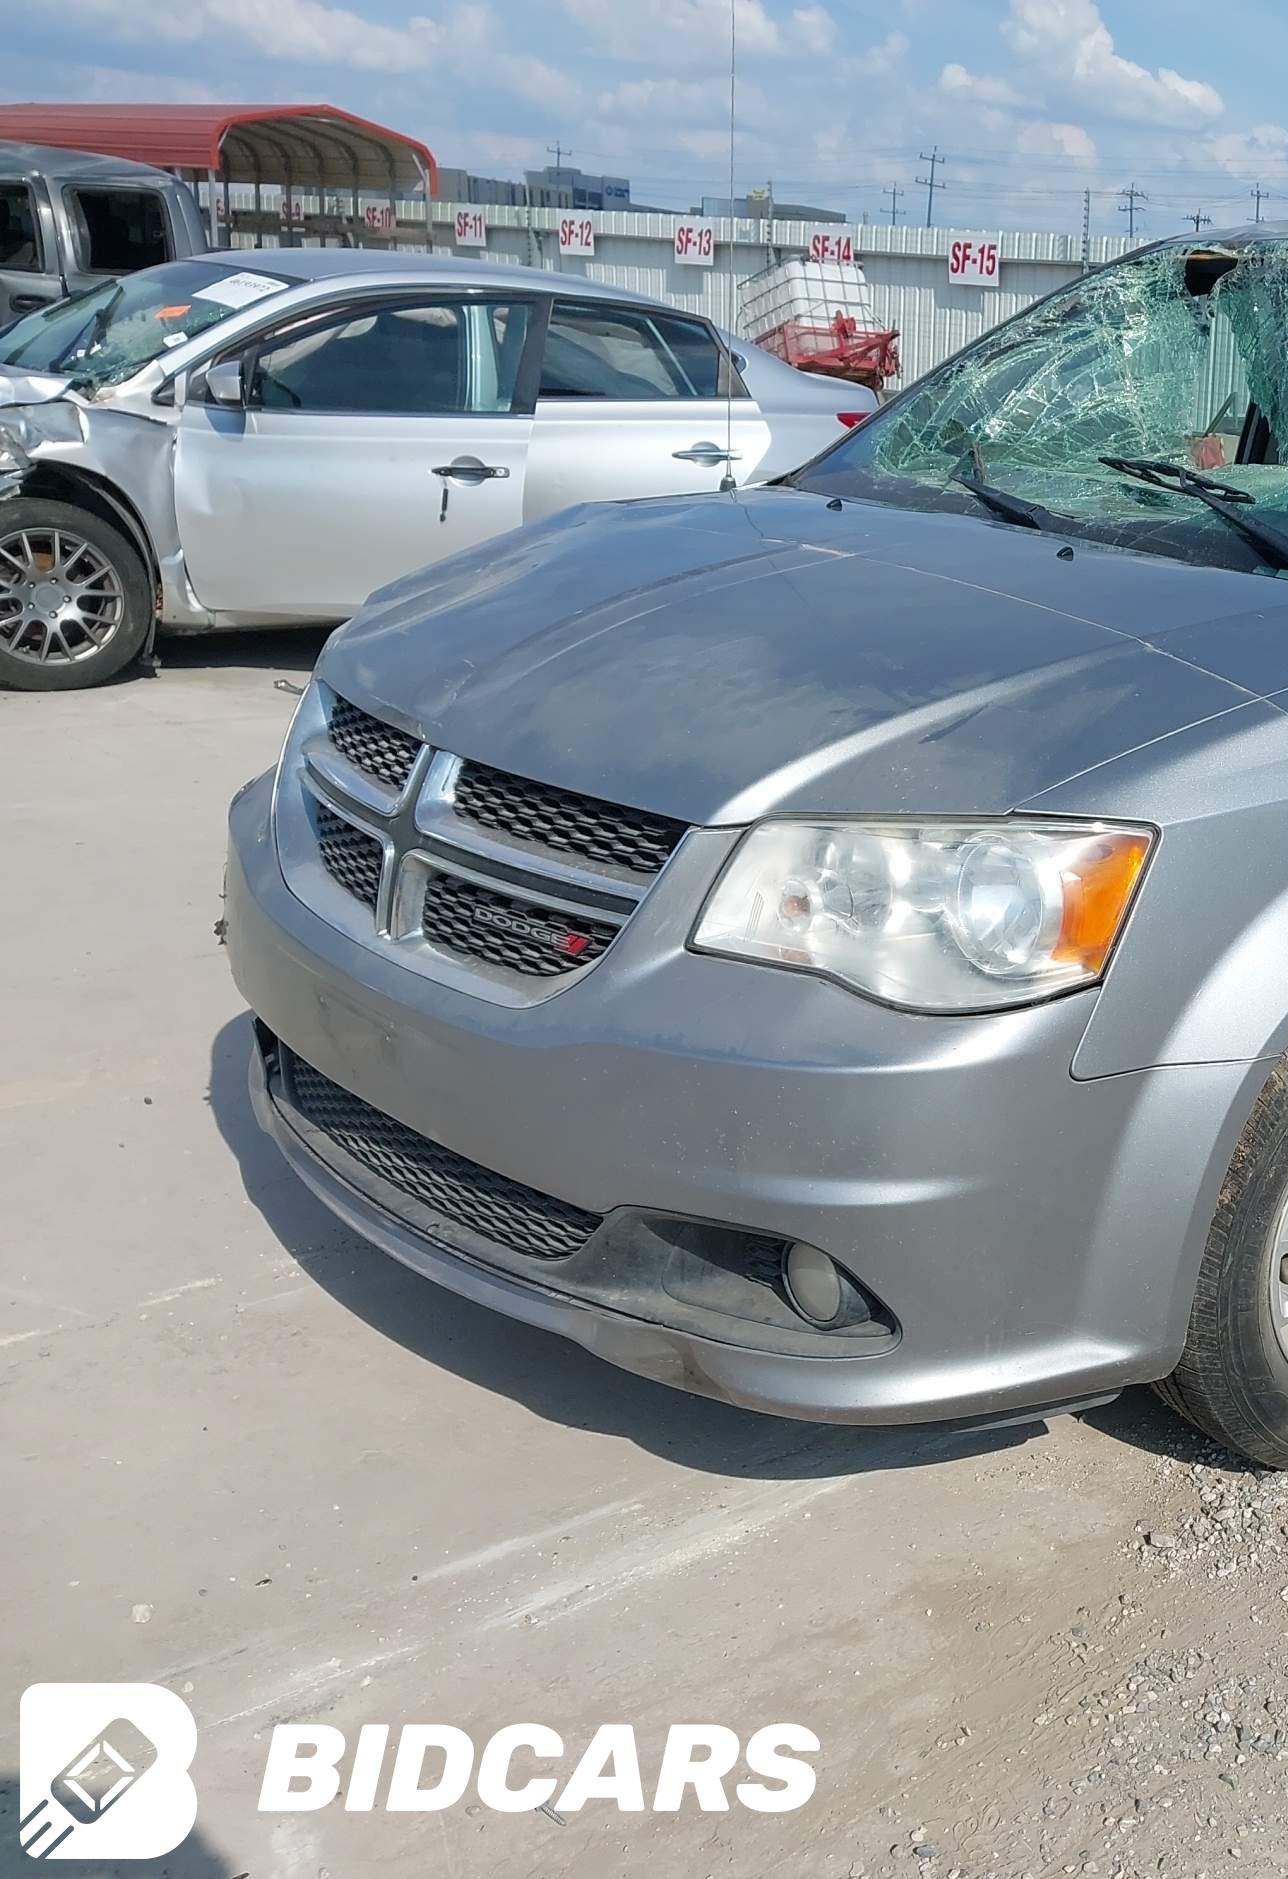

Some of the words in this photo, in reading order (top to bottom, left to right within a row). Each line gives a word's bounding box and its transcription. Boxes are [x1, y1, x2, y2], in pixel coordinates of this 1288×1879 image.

[456, 212, 483, 238] SF-11
[560, 219, 592, 247] SF-12
[676, 227, 712, 256] SF-13
[811, 235, 852, 261] SF-14
[950, 242, 997, 276] SF-15
[474, 906, 571, 950] DODGE
